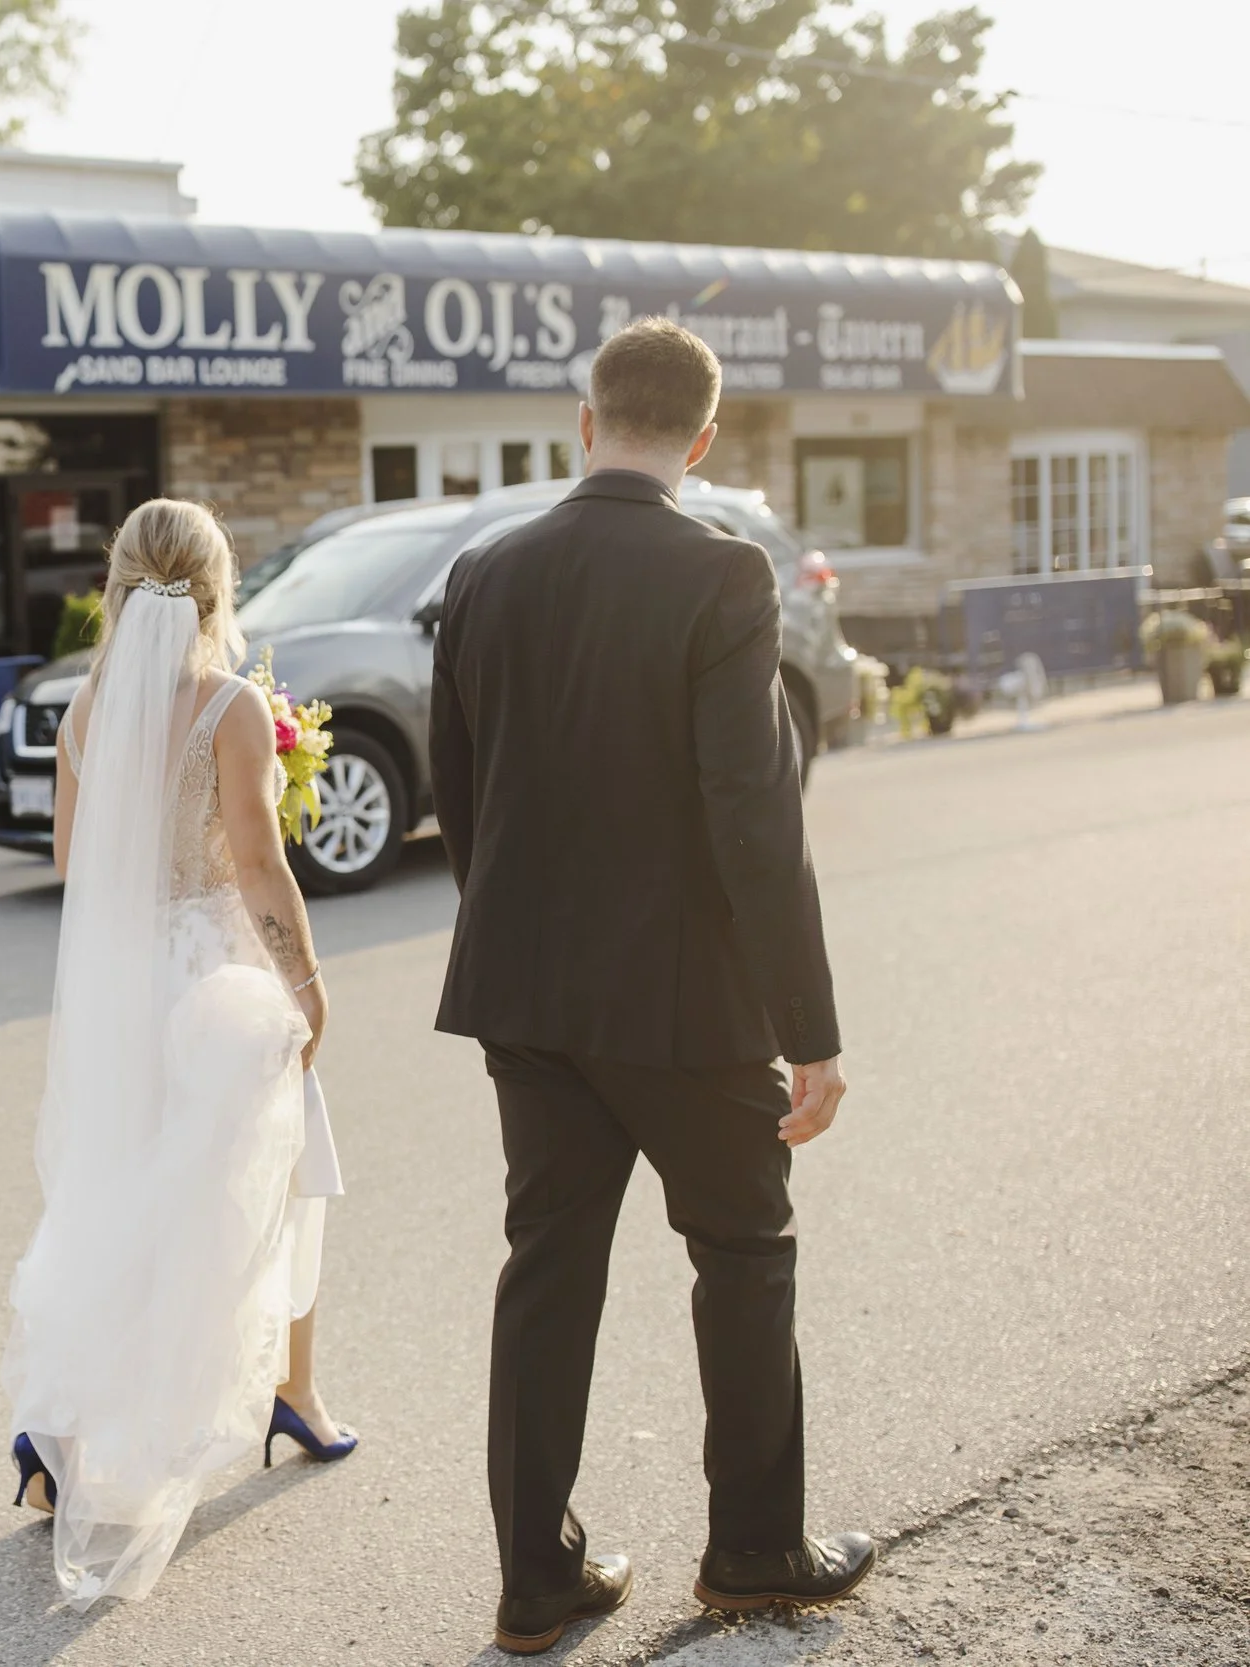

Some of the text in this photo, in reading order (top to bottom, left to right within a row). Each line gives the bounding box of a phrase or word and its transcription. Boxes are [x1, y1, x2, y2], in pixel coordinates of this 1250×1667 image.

[41, 262, 323, 351] MOLLY
[425, 278, 577, 371] O.J.'S
[77, 355, 287, 386] SAND BAR LOUNGE
